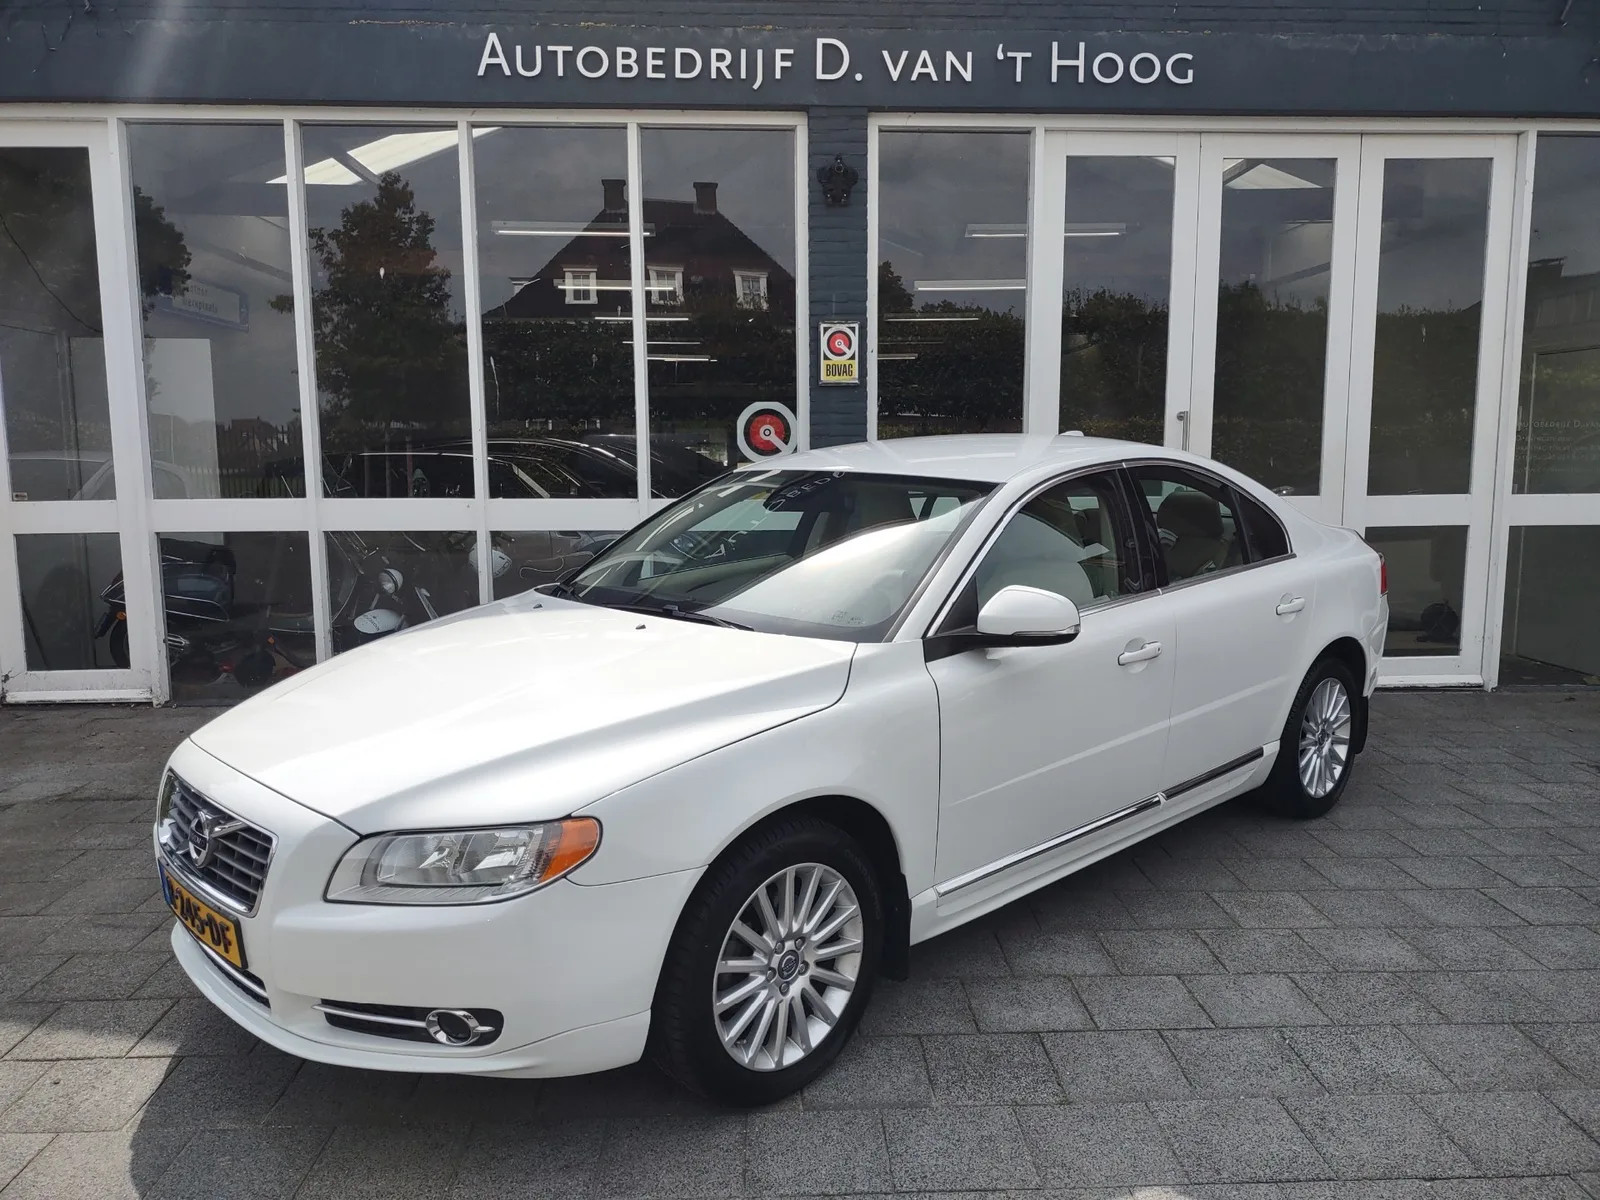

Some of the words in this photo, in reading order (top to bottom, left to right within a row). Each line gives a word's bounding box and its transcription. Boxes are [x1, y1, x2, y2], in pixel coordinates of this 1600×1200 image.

[477, 32, 794, 90] AUTOBEDRIJF
[815, 37, 863, 82] D.
[882, 49, 973, 82] VAN
[1051, 41, 1194, 84] HOOG
[825, 363, 854, 377] BOVAG
